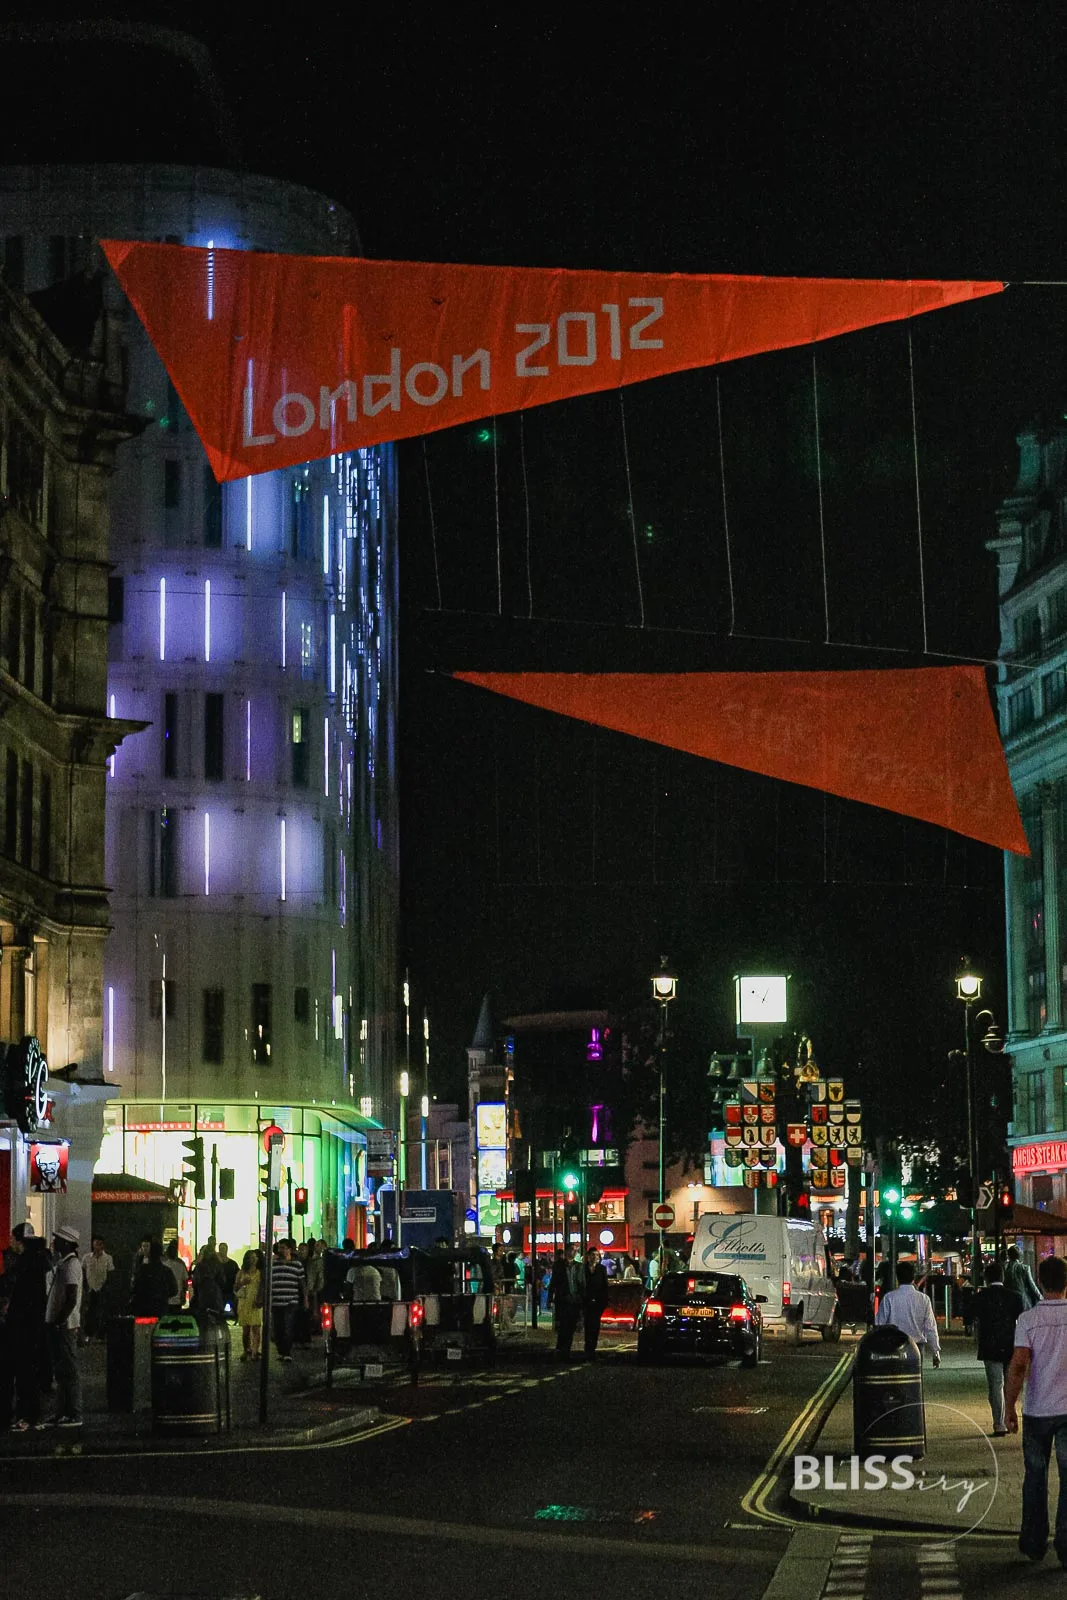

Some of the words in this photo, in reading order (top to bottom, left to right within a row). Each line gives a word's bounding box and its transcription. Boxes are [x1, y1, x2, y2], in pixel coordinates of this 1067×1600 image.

[242, 347, 491, 448] London
[514, 297, 664, 377] 2012
[1012, 1147, 1037, 1167] ANGUS
[1037, 1144, 1061, 1164] STEAK
